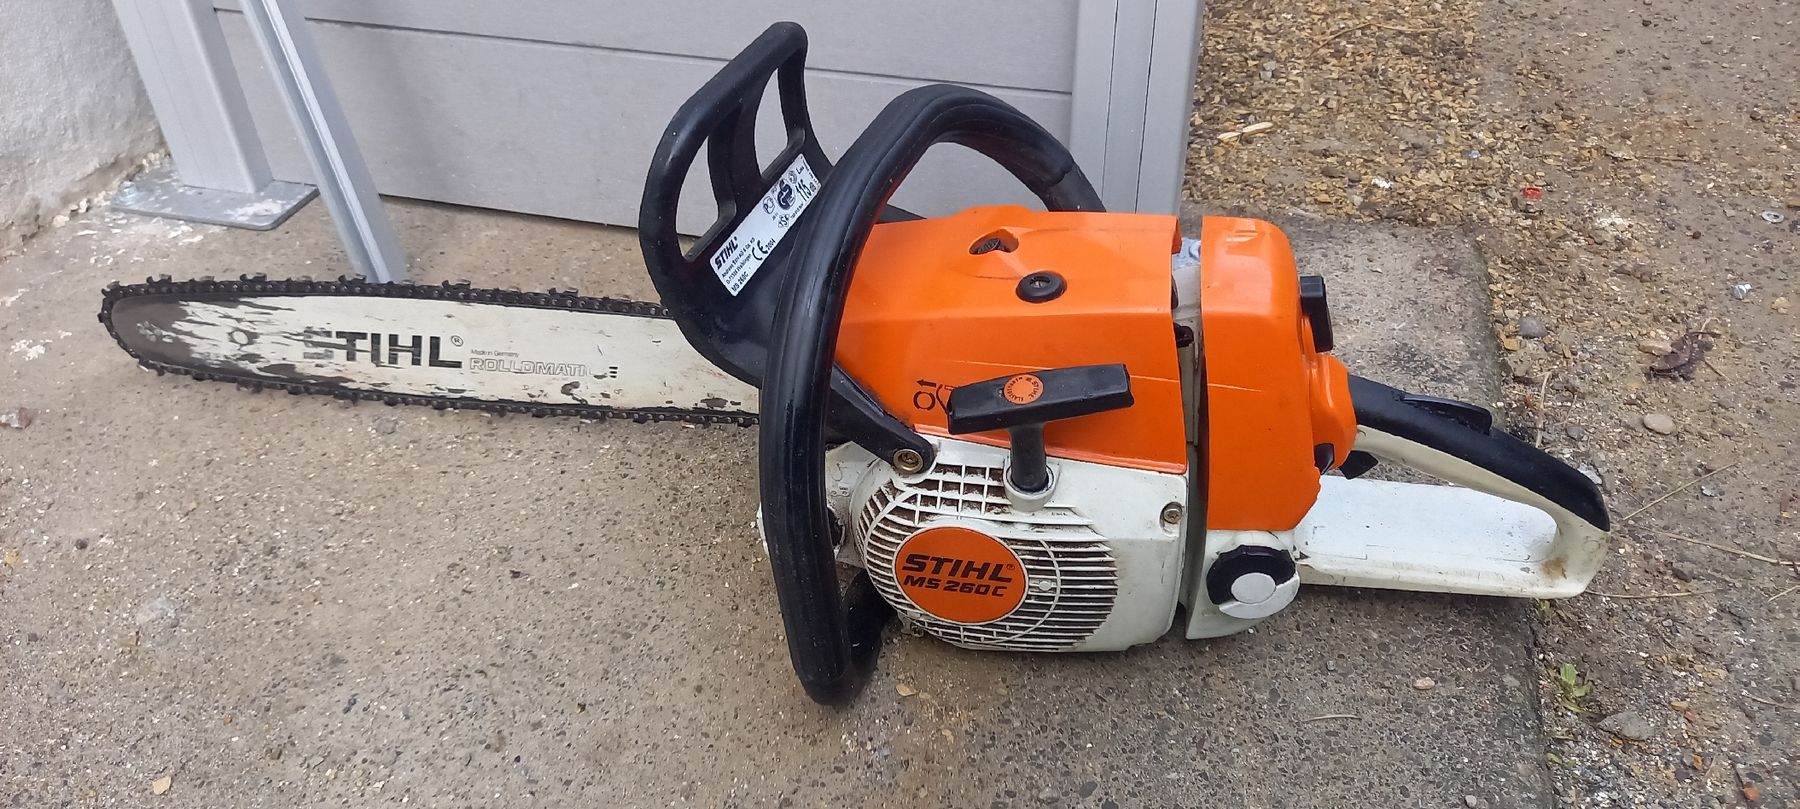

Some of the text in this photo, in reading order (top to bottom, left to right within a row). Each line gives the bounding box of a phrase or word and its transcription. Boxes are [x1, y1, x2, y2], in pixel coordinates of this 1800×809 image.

[715, 237, 738, 270] STIHL
[470, 358, 597, 378] ROLLOMATI
[902, 554, 1012, 583] STIHL
[904, 575, 941, 589] MS
